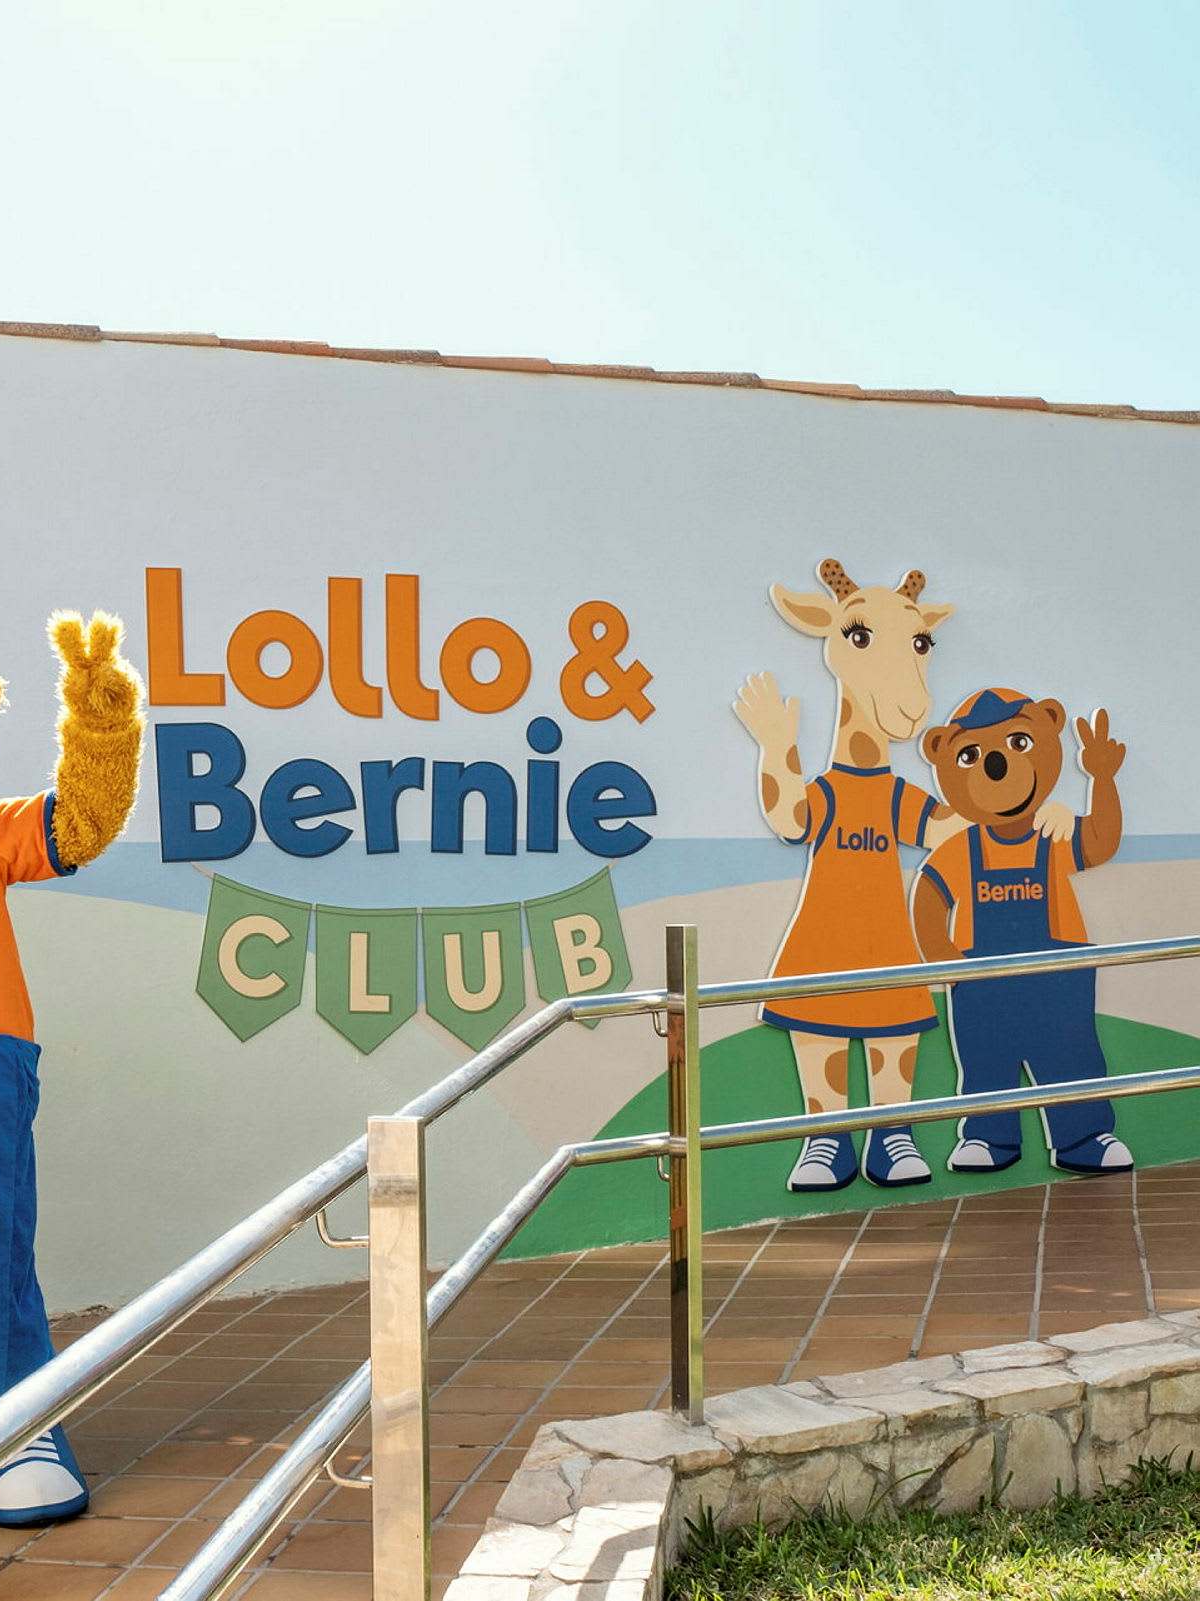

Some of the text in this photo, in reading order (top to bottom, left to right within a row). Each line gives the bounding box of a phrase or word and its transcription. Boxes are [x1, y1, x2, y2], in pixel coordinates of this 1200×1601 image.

[145, 567, 657, 724] Lollo &
[155, 716, 657, 863] Bernie
[836, 827, 889, 852] Lollo
[976, 878, 1044, 903] Bernie
[217, 913, 614, 1012] CLUB
